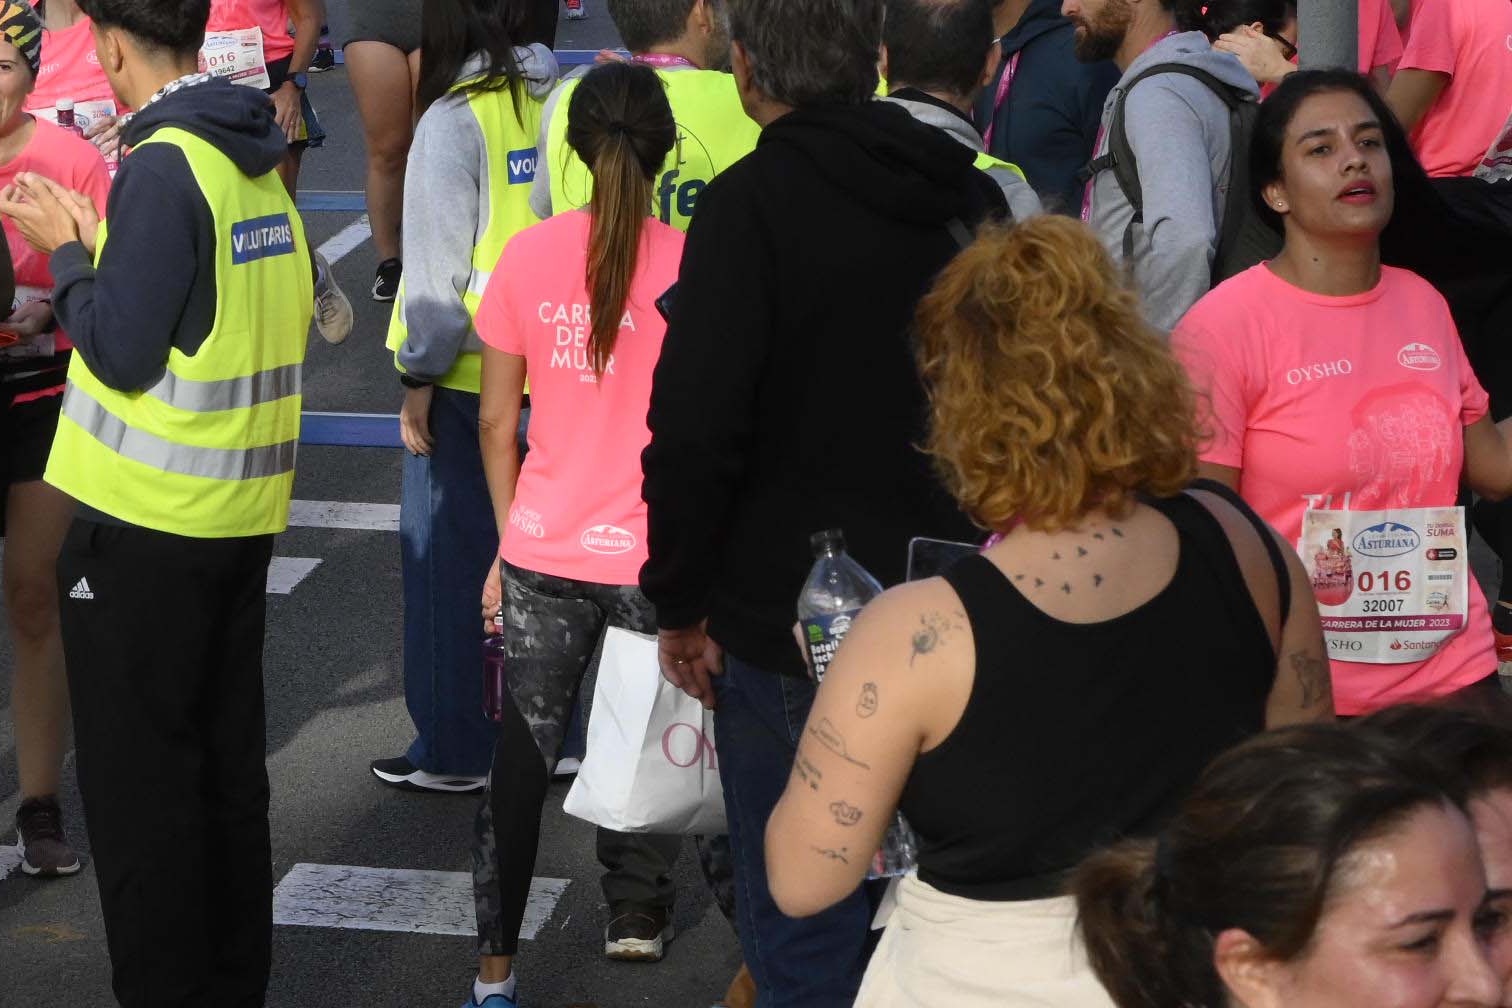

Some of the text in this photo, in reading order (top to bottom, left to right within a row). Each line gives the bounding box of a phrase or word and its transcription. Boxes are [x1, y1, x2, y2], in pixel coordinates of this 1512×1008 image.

[209, 52, 235, 66] 016
[556, 326, 584, 348] DE
[1402, 353, 1440, 366] ASTURIANA
[1287, 358, 1352, 385] OYSHO
[510, 510, 545, 538] OYSHO
[1426, 528, 1455, 537] SUMA
[584, 533, 631, 548] ASTURIANA
[1357, 536, 1416, 551] ASTURIANA
[1357, 570, 1412, 592] 016
[70, 590, 94, 600] adidas
[1362, 599, 1404, 612] 32007
[1365, 620, 1378, 628] DE
[1379, 620, 1392, 628] LA
[1394, 619, 1426, 628] MUJER
[1429, 618, 1450, 627] 2023
[1330, 640, 1363, 651] SHO
